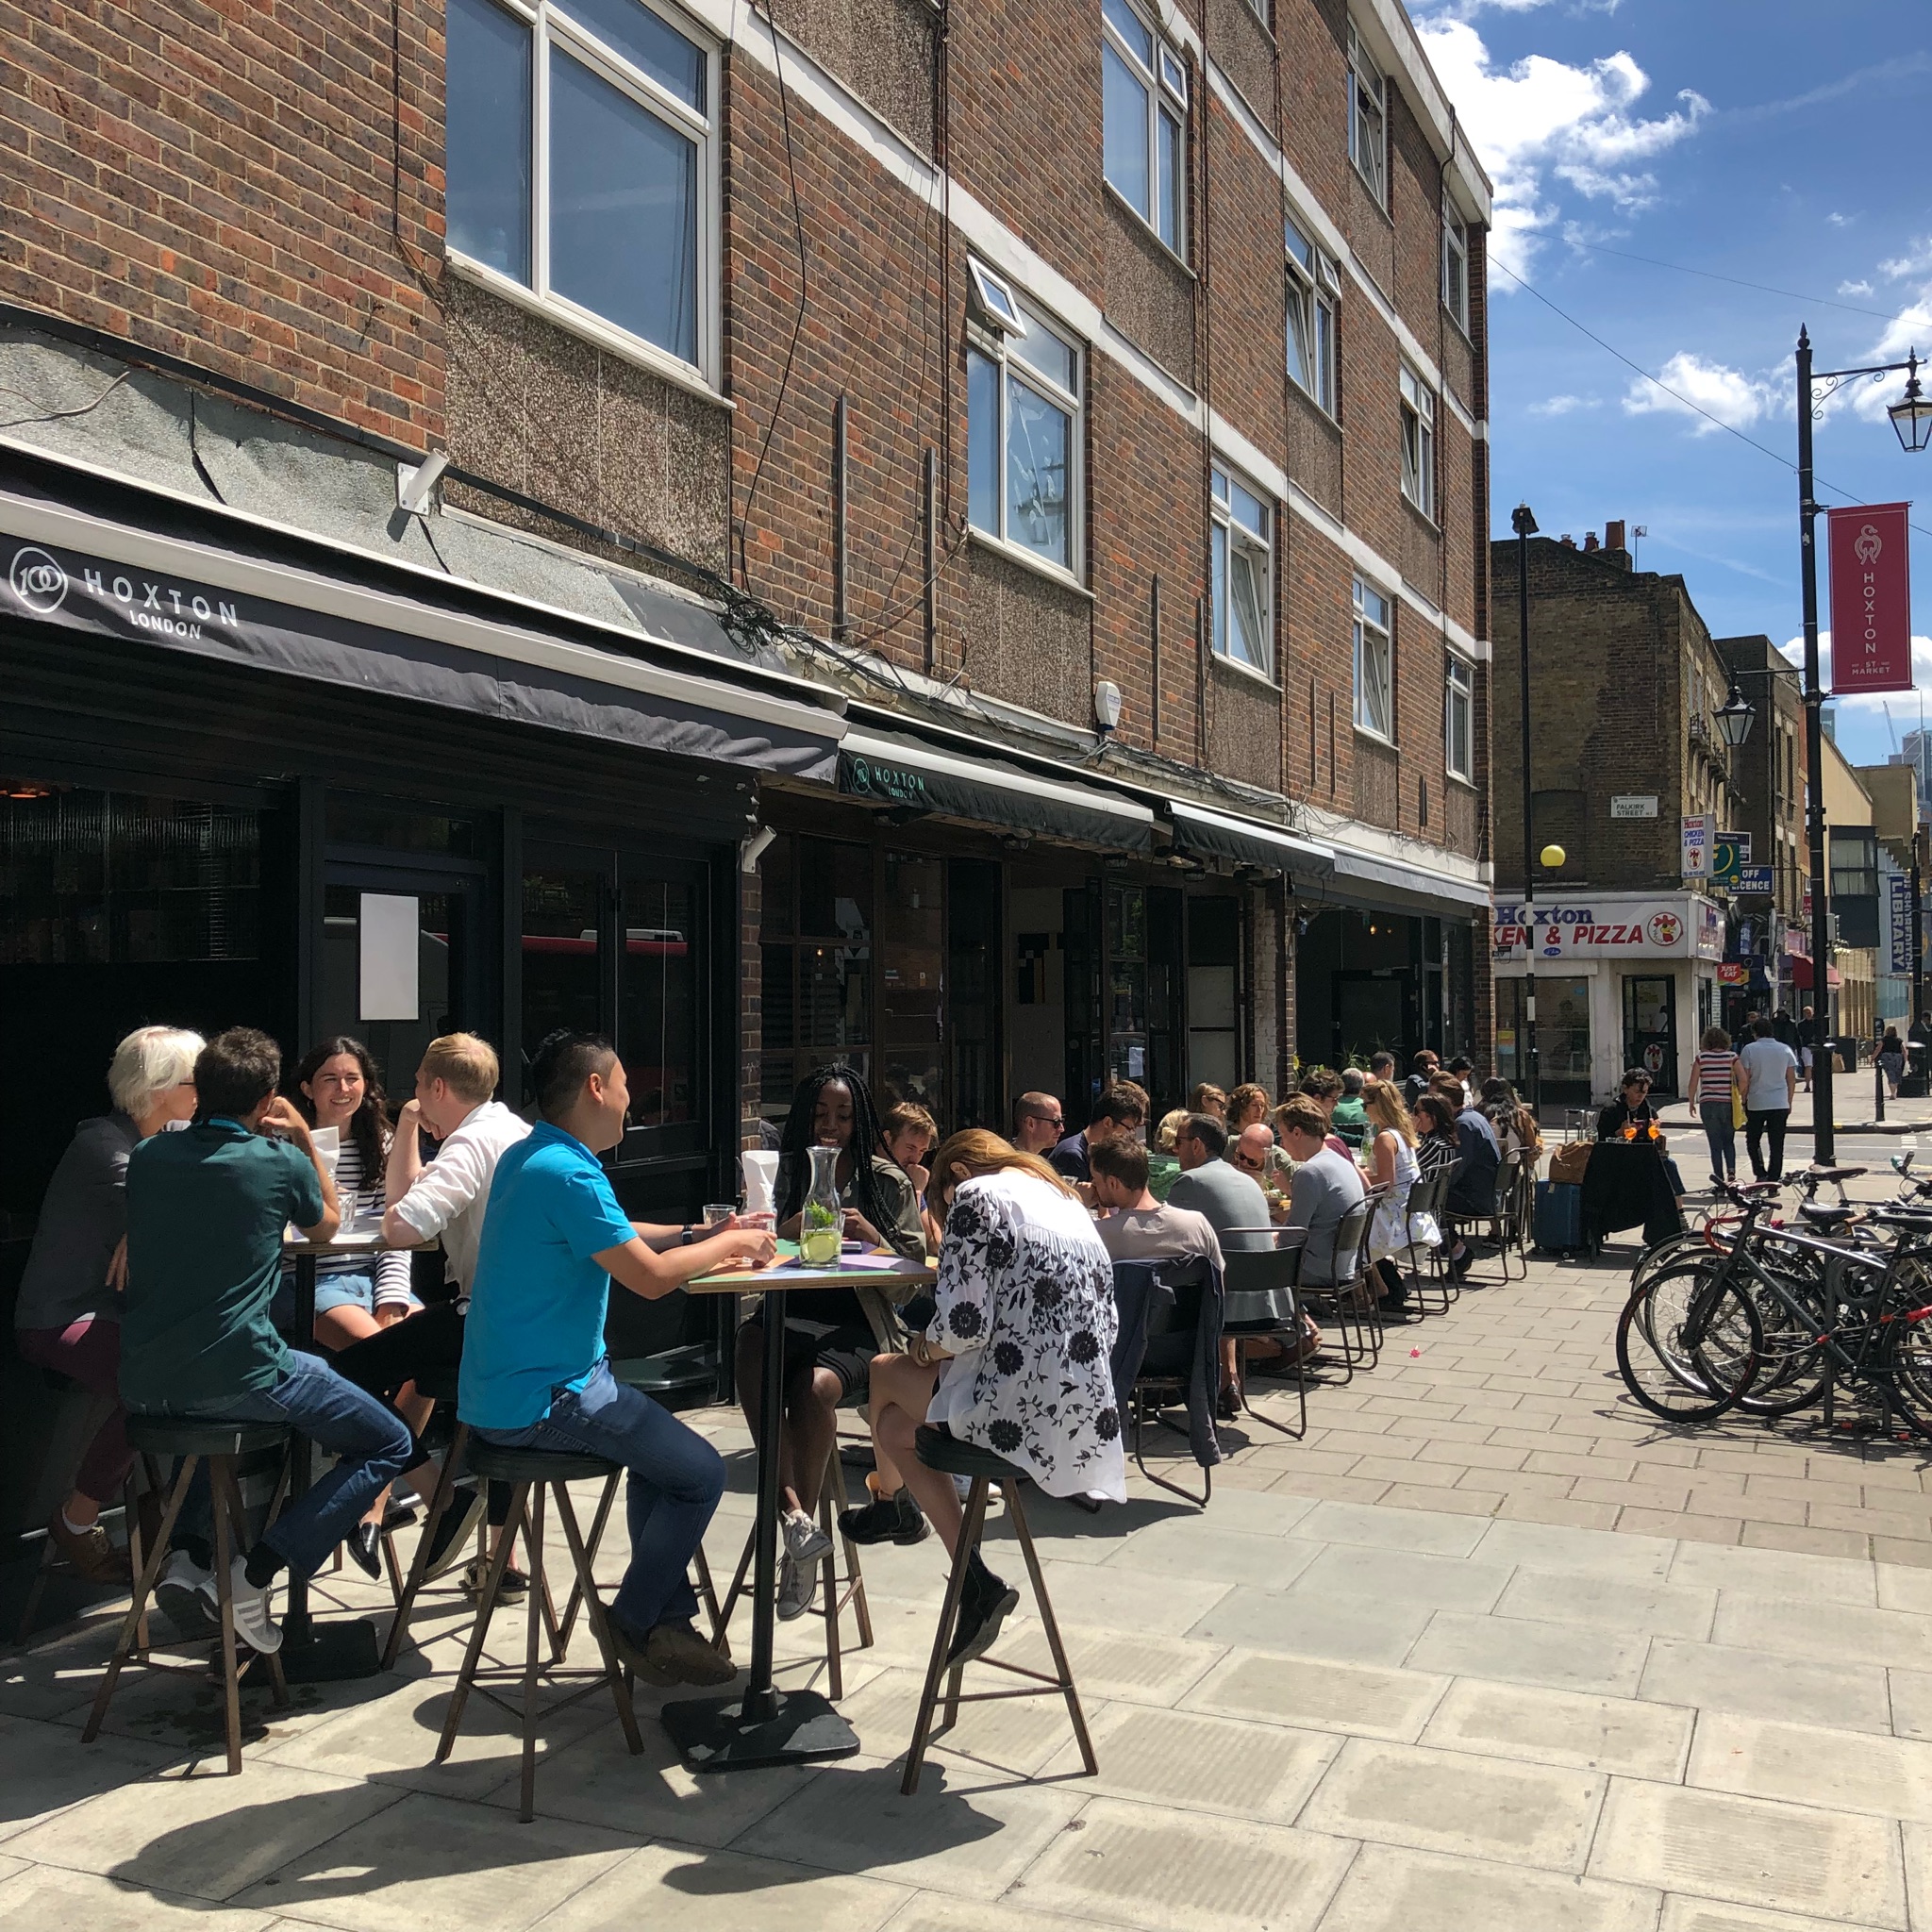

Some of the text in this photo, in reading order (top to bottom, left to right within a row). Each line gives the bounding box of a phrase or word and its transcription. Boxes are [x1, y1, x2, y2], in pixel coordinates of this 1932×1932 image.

[84, 568, 239, 627] HOXTON
[1863, 572, 1876, 654] HOXTON
[129, 609, 201, 640] LONDON
[1852, 666, 1890, 675] MARKET
[874, 766, 924, 791] HOXTON
[888, 786, 913, 800] LONDON
[1684, 818, 1704, 829] Hoxton
[1683, 830, 1705, 839] CHICKEN
[1689, 838, 1705, 847] PIZZA
[1741, 869, 1759, 878] OFF
[1891, 881, 1905, 968] LIBRARY
[1545, 925, 1561, 945] &
[1573, 925, 1643, 944] PIZZA
